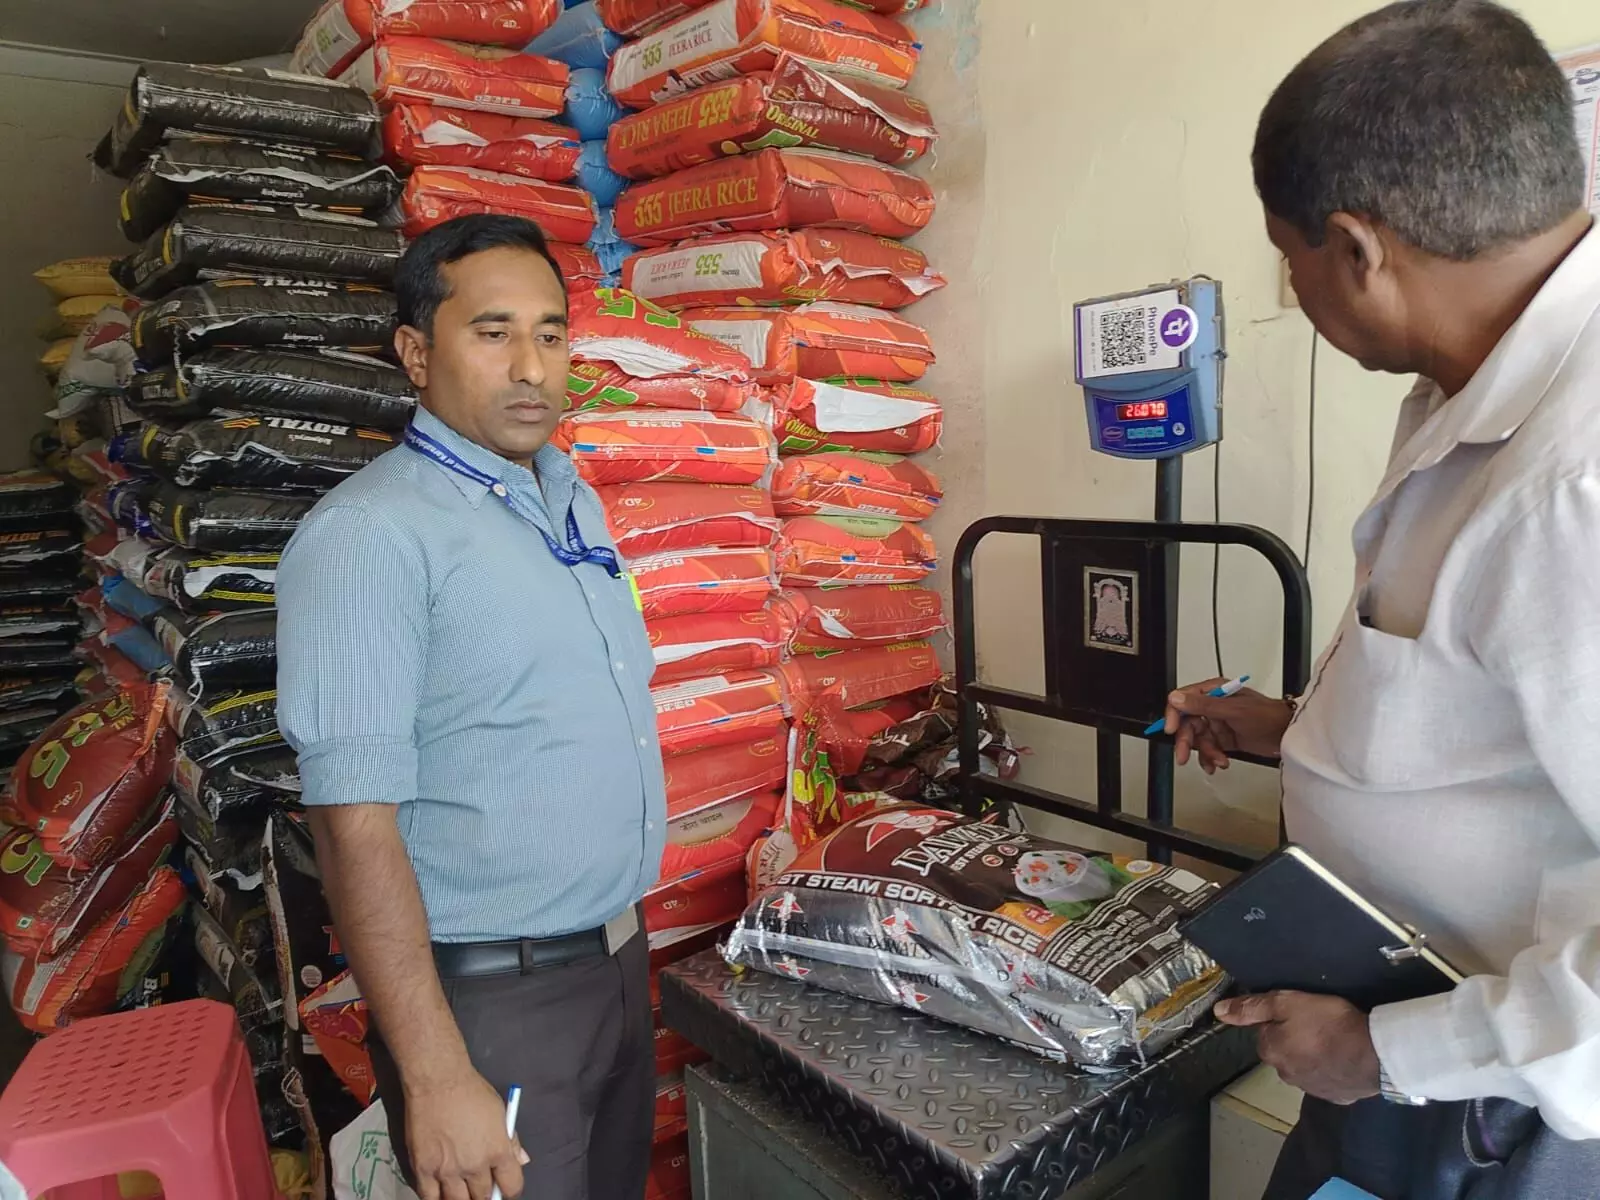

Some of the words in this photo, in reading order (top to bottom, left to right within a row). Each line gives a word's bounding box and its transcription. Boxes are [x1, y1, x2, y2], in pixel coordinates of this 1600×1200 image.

[642, 40, 664, 70] 555
[653, 99, 694, 136] JEERA
[698, 86, 738, 128] 555
[634, 190, 665, 228] 555
[667, 186, 713, 222] JEERA
[716, 176, 758, 208] RICE
[694, 253, 723, 277] 555
[1148, 306, 1158, 356] PhonePe
[263, 416, 350, 436] ROYAL
[806, 875, 880, 895] STEAM
[982, 914, 1042, 953] RICE
